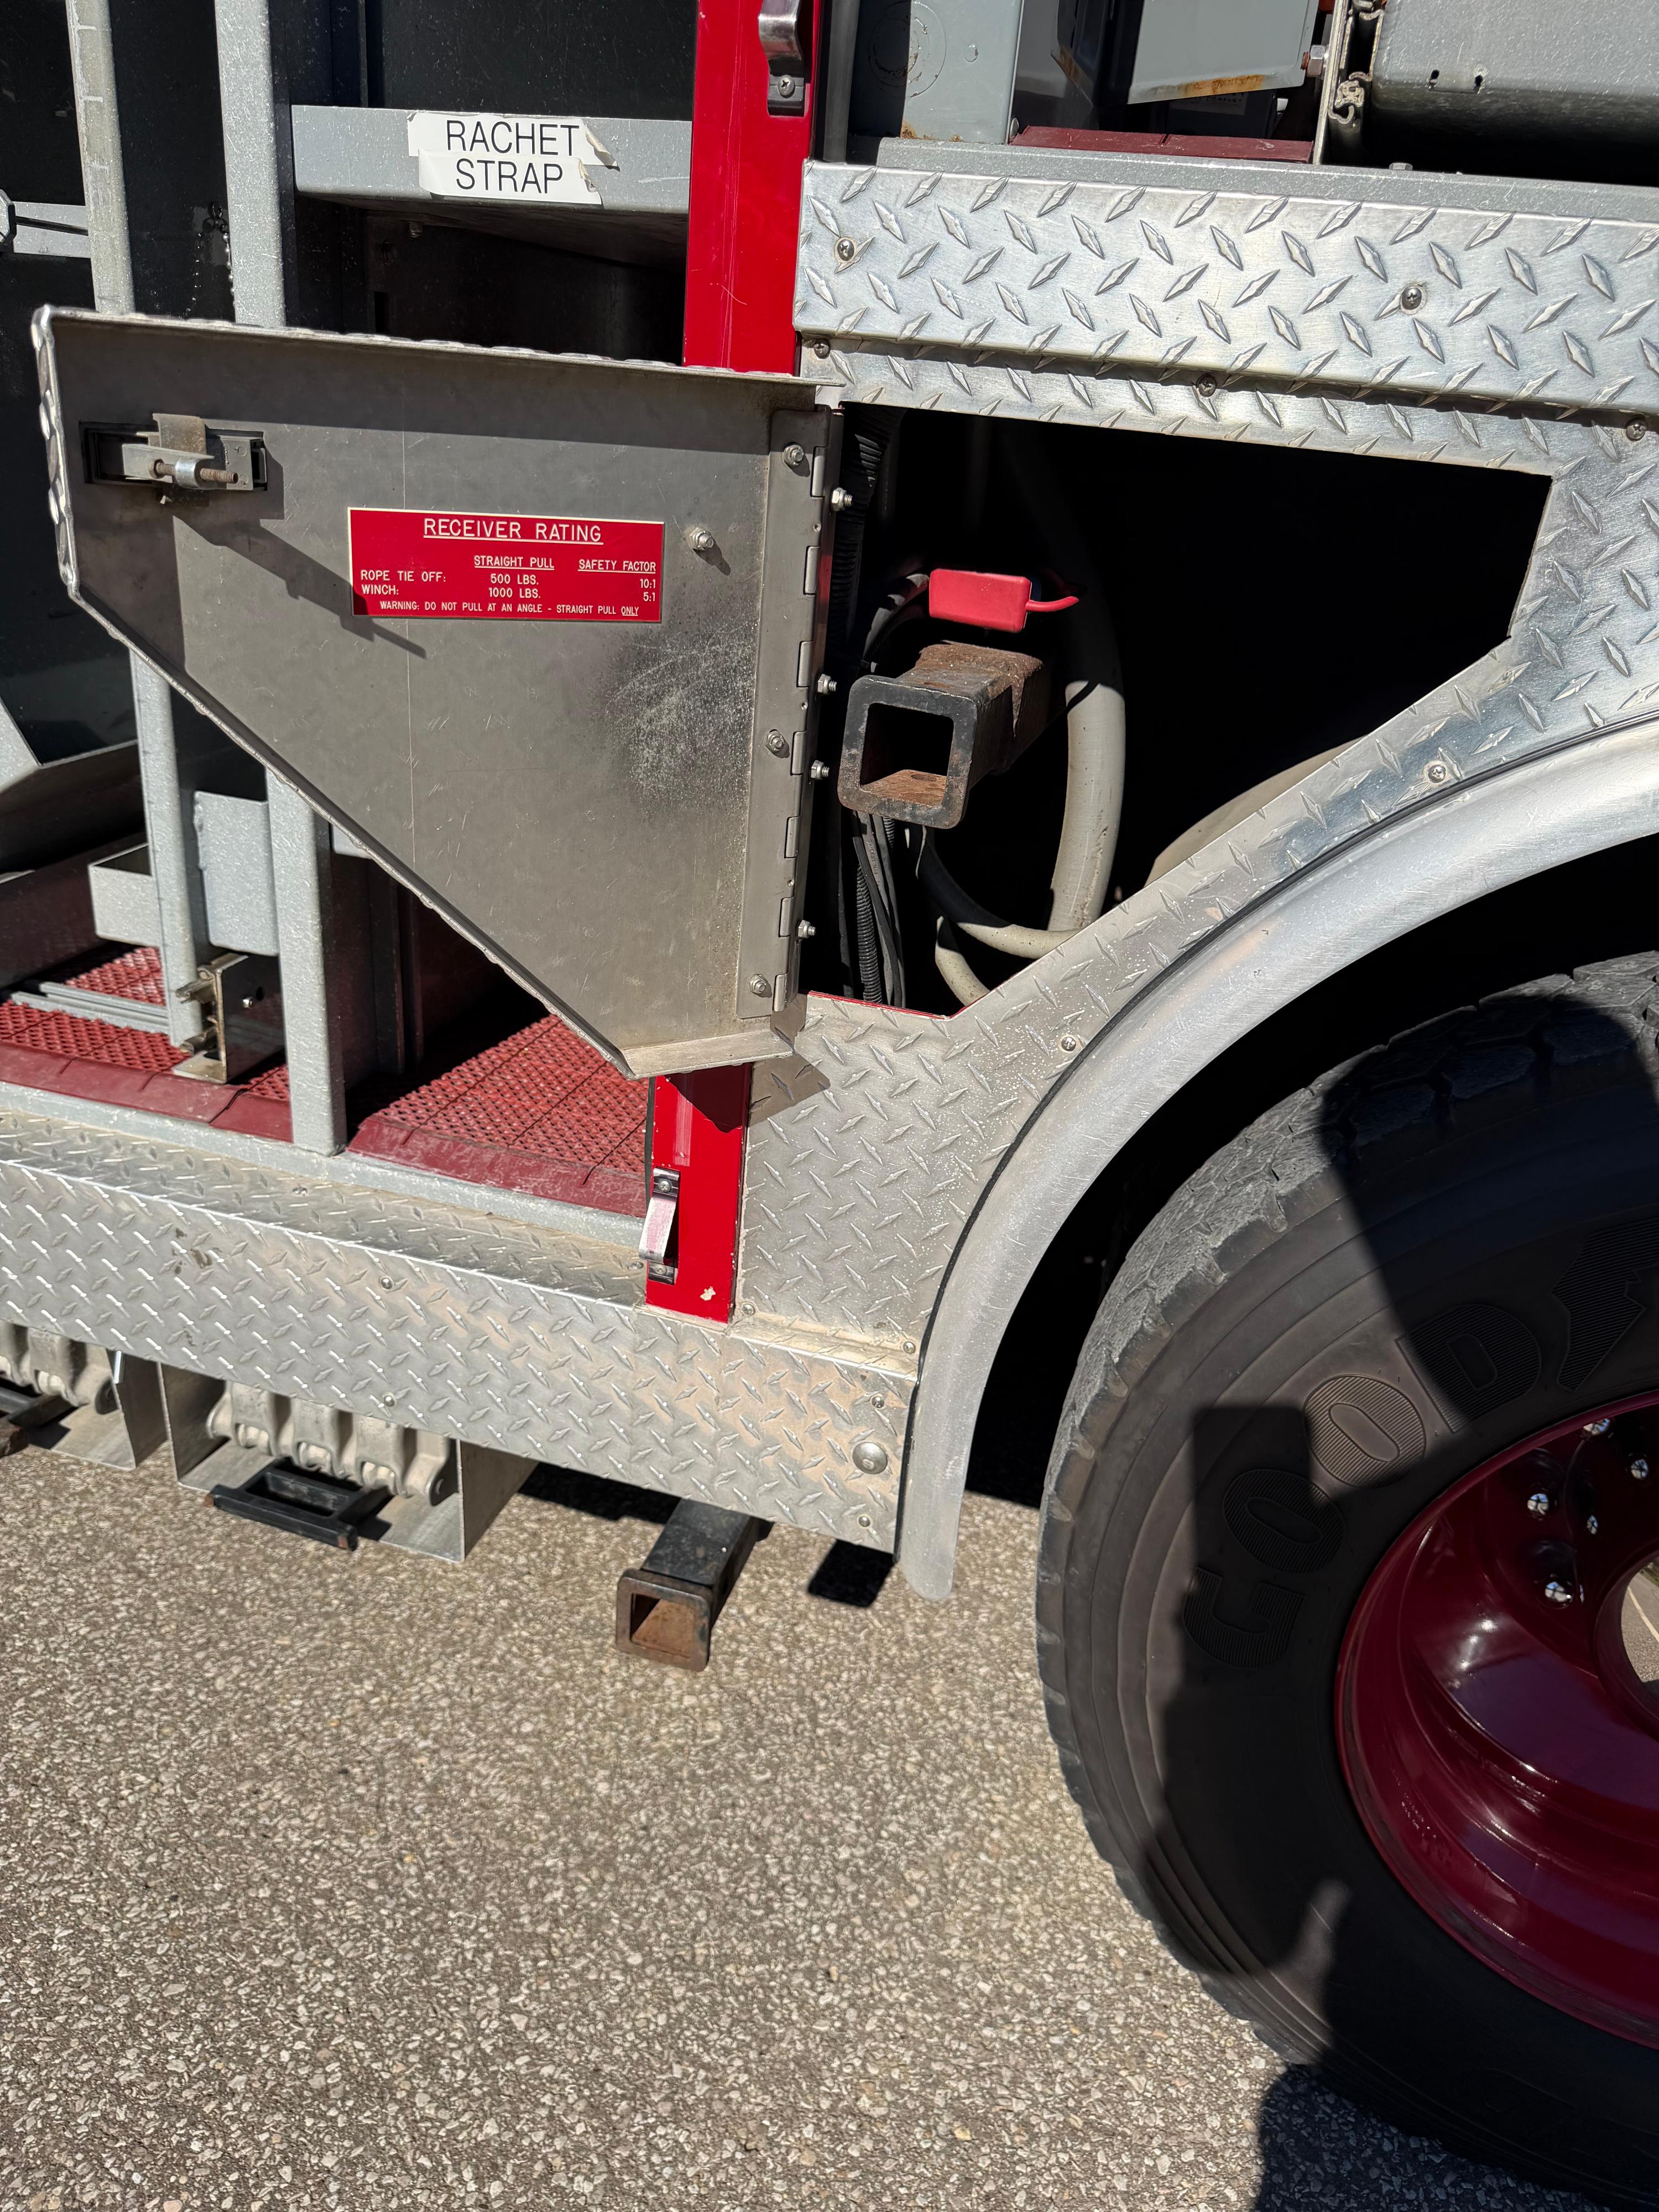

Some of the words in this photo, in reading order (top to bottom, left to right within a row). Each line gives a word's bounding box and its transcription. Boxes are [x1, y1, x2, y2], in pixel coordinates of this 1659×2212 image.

[446, 119, 580, 157] RACHET
[456, 158, 563, 194] STRAP
[424, 518, 521, 540] RECEIVER
[536, 523, 602, 542] RATING
[474, 555, 524, 567] STRAIGHT
[529, 557, 555, 568] PULL
[578, 559, 617, 571] SAFETY
[623, 561, 656, 572] FACTOR
[361, 570, 390, 581] ROPE
[397, 571, 414, 582] TIE
[421, 571, 446, 582] OFF:
[491, 573, 510, 585] 500
[517, 575, 539, 585] LBS.
[361, 584, 399, 595] WINCH:
[640, 578, 656, 589] 10:1
[489, 587, 513, 598] 1000
[519, 588, 541, 598] LBS.
[643, 592, 655, 602] 5:1
[380, 601, 420, 611] WARNING:
[425, 602, 436, 611] DO
[441, 602, 457, 611] NOT
[462, 602, 482, 612] PULL
[487, 603, 497, 612] AT
[502, 604, 512, 612] AN
[518, 604, 542, 613] ANGLE
[556, 604, 593, 614] STRAIGHT
[598, 606, 616, 614] PULL
[621, 606, 639, 615] ONLY
